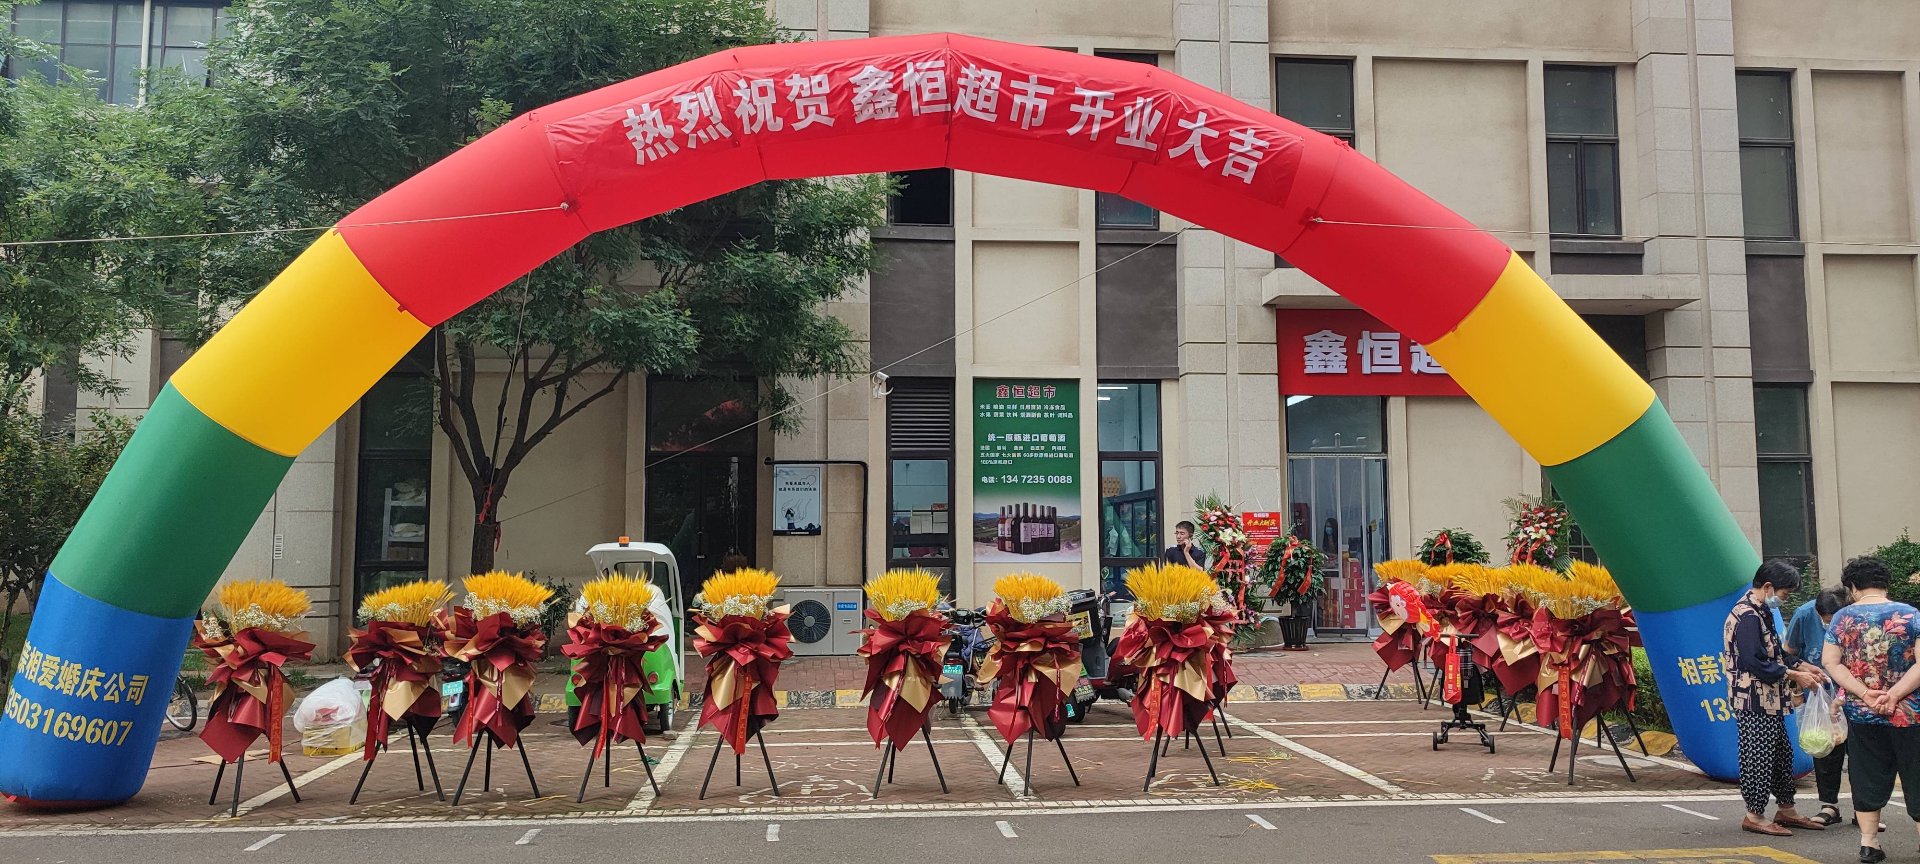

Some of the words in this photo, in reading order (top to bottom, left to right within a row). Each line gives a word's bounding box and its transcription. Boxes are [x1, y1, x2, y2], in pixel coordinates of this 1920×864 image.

[996, 385, 1057, 399] 鑫恒超市
[1000, 475, 1018, 484] 134
[1020, 475, 1046, 484] 7235
[1047, 475, 1073, 484] 0088
